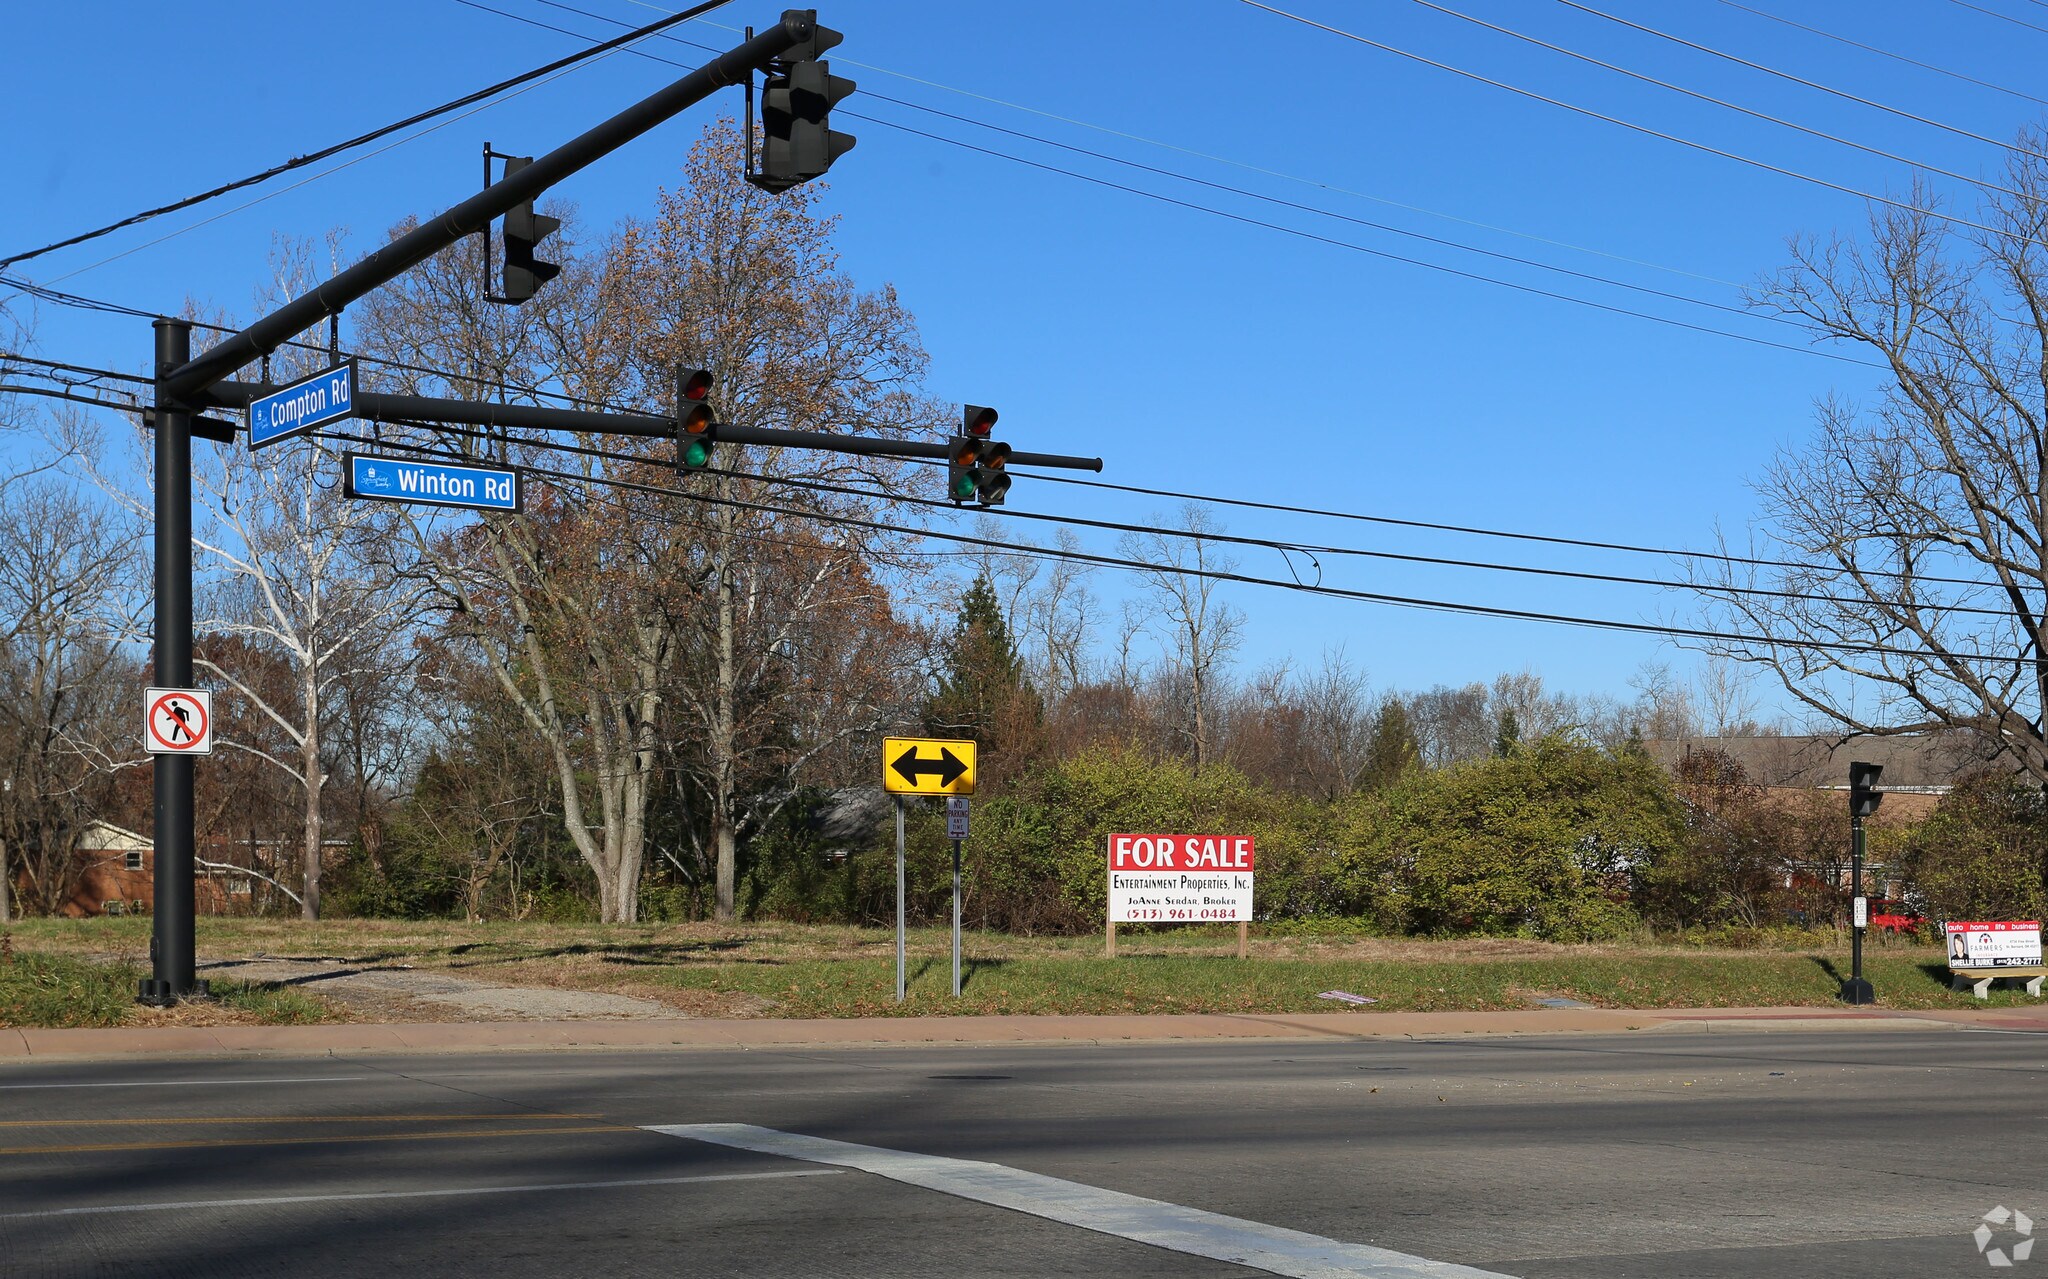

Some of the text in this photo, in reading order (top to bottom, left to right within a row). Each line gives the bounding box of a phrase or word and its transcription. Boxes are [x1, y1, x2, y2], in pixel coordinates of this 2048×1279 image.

[270, 373, 349, 427] Compton Rd
[397, 468, 511, 502] Winton Rd
[953, 801, 963, 809] NO
[948, 810, 968, 818] PARKING
[1115, 837, 1249, 868] FOR SALE
[1127, 909, 1237, 920] (513) 961-0484
[1970, 944, 2003, 952] FARMERS
[1975, 958, 1994, 966] BURKE
